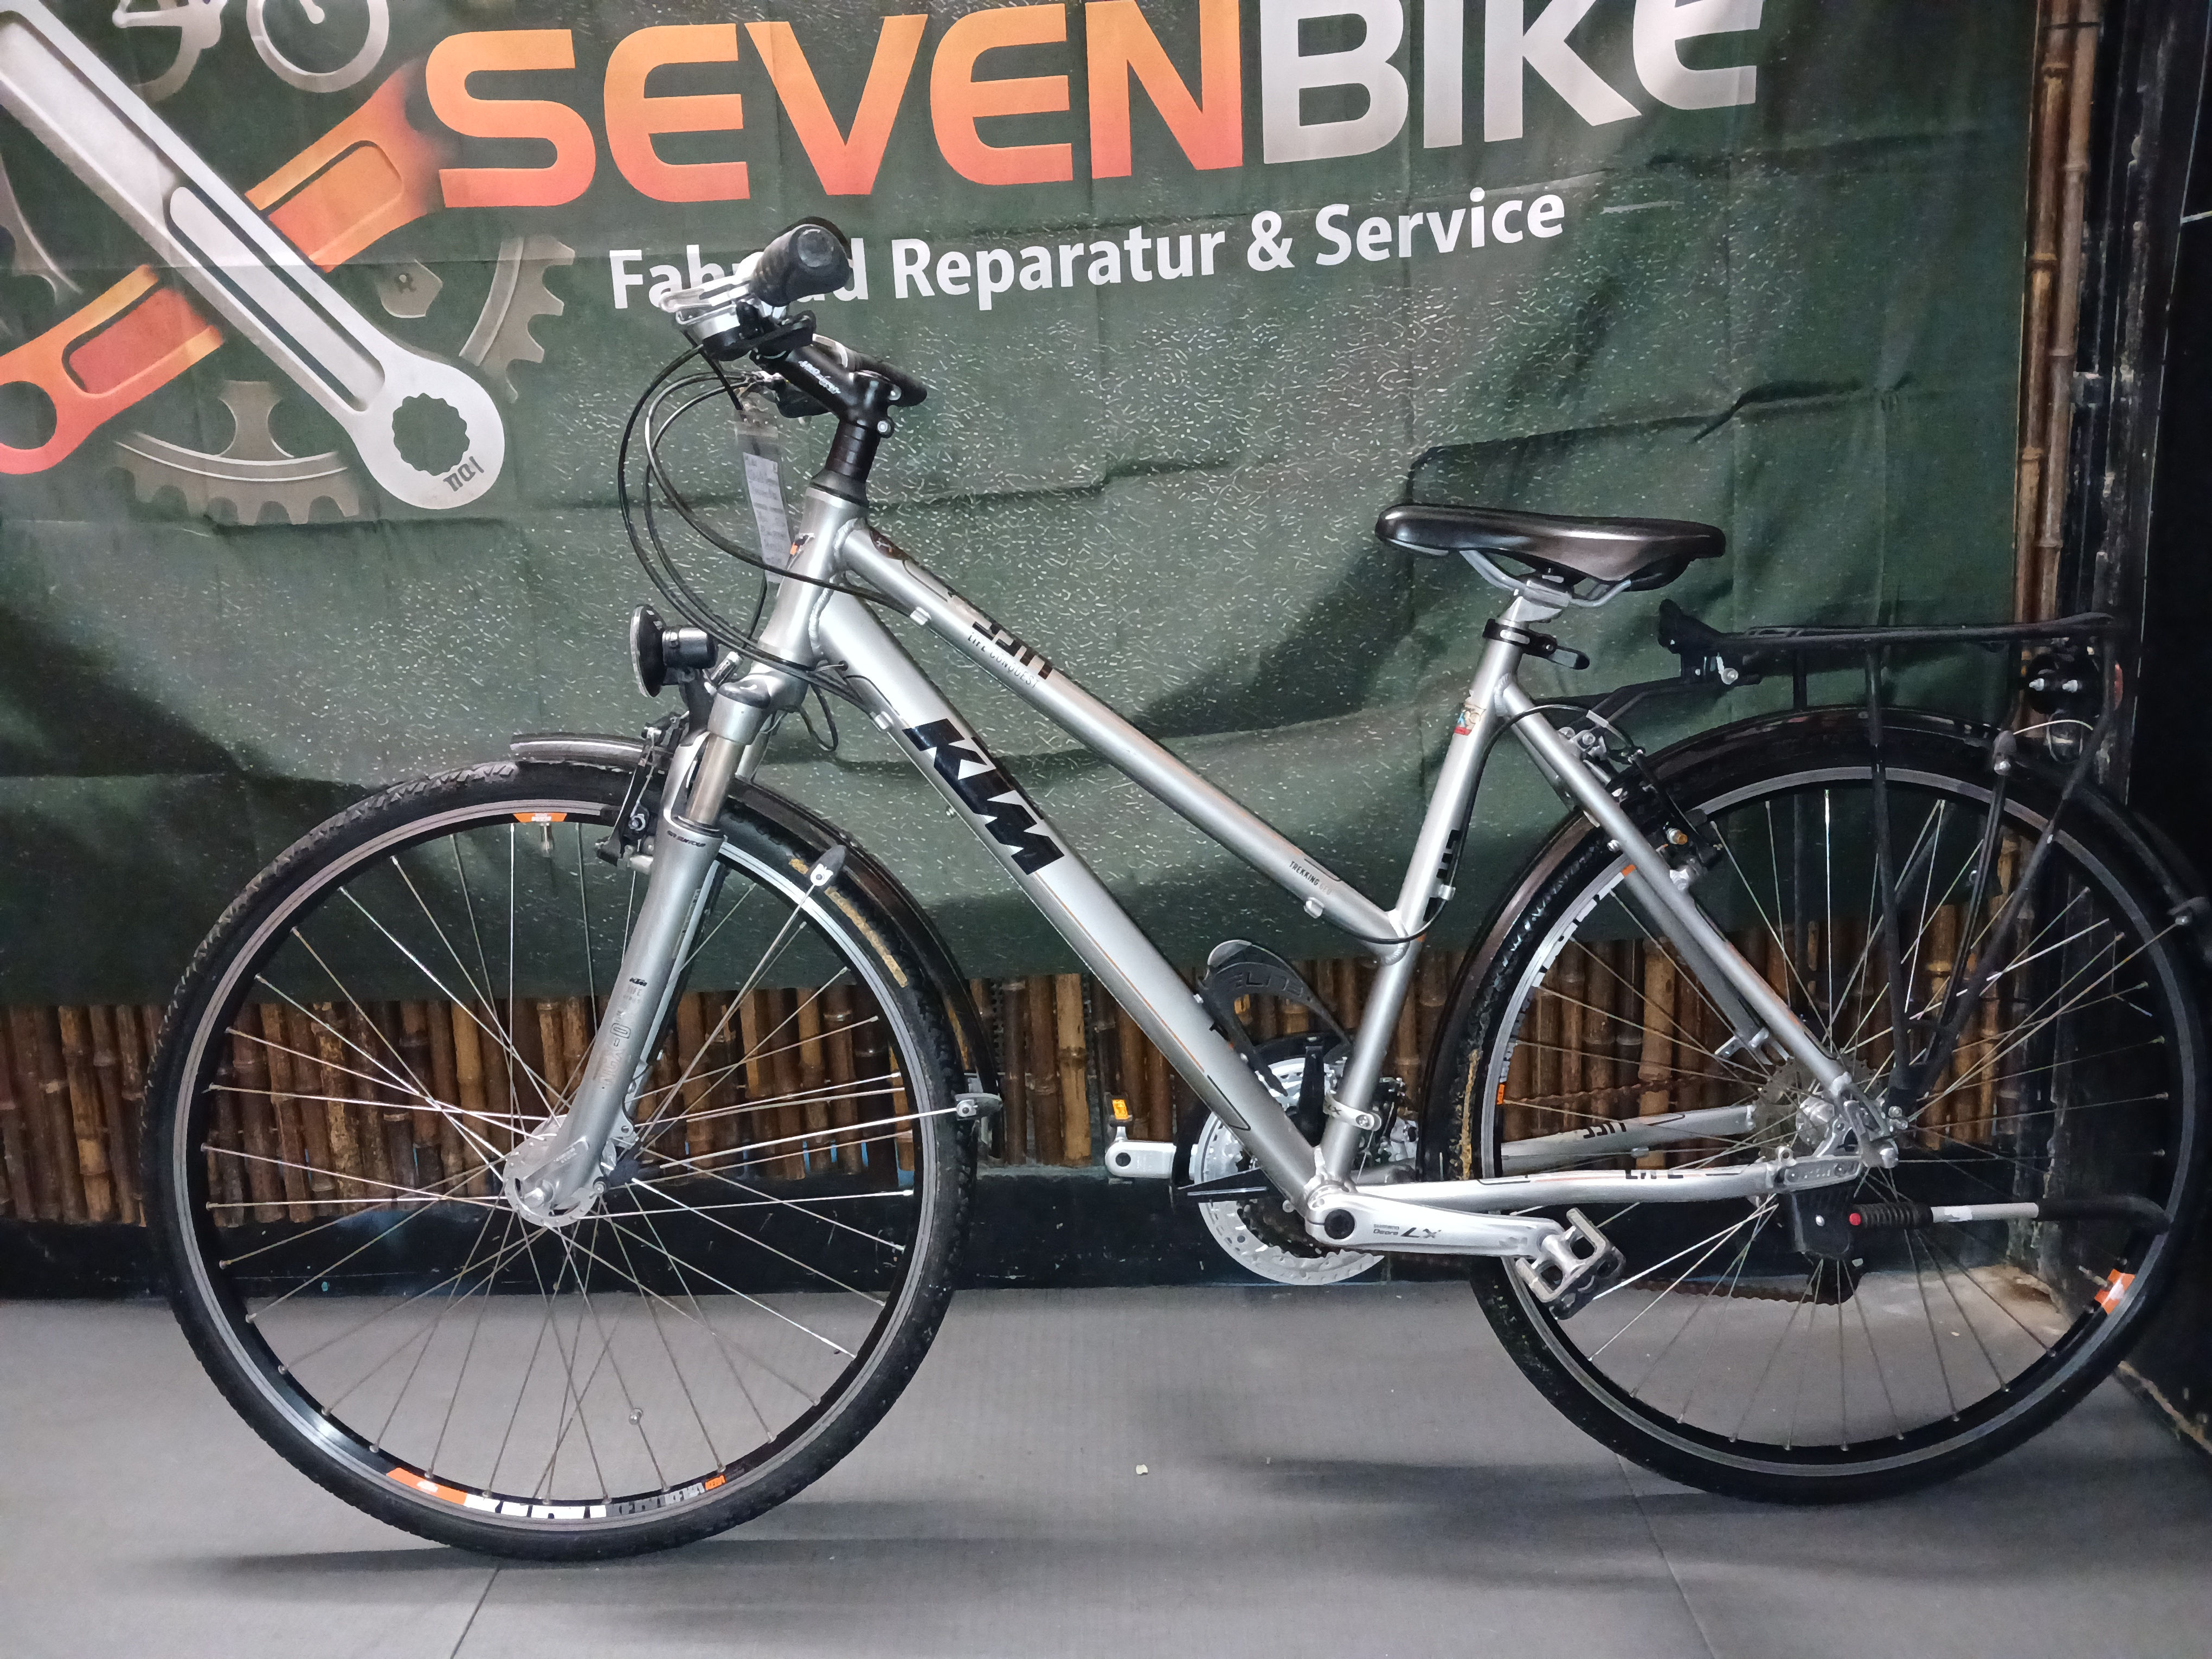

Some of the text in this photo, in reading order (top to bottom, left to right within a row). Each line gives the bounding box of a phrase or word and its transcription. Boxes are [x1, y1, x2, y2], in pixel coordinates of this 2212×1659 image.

[610, 187, 1565, 311] Fahd Reparatur & Service
[902, 718, 1065, 875] KTM
[1289, 860, 1320, 886] TREKKING
